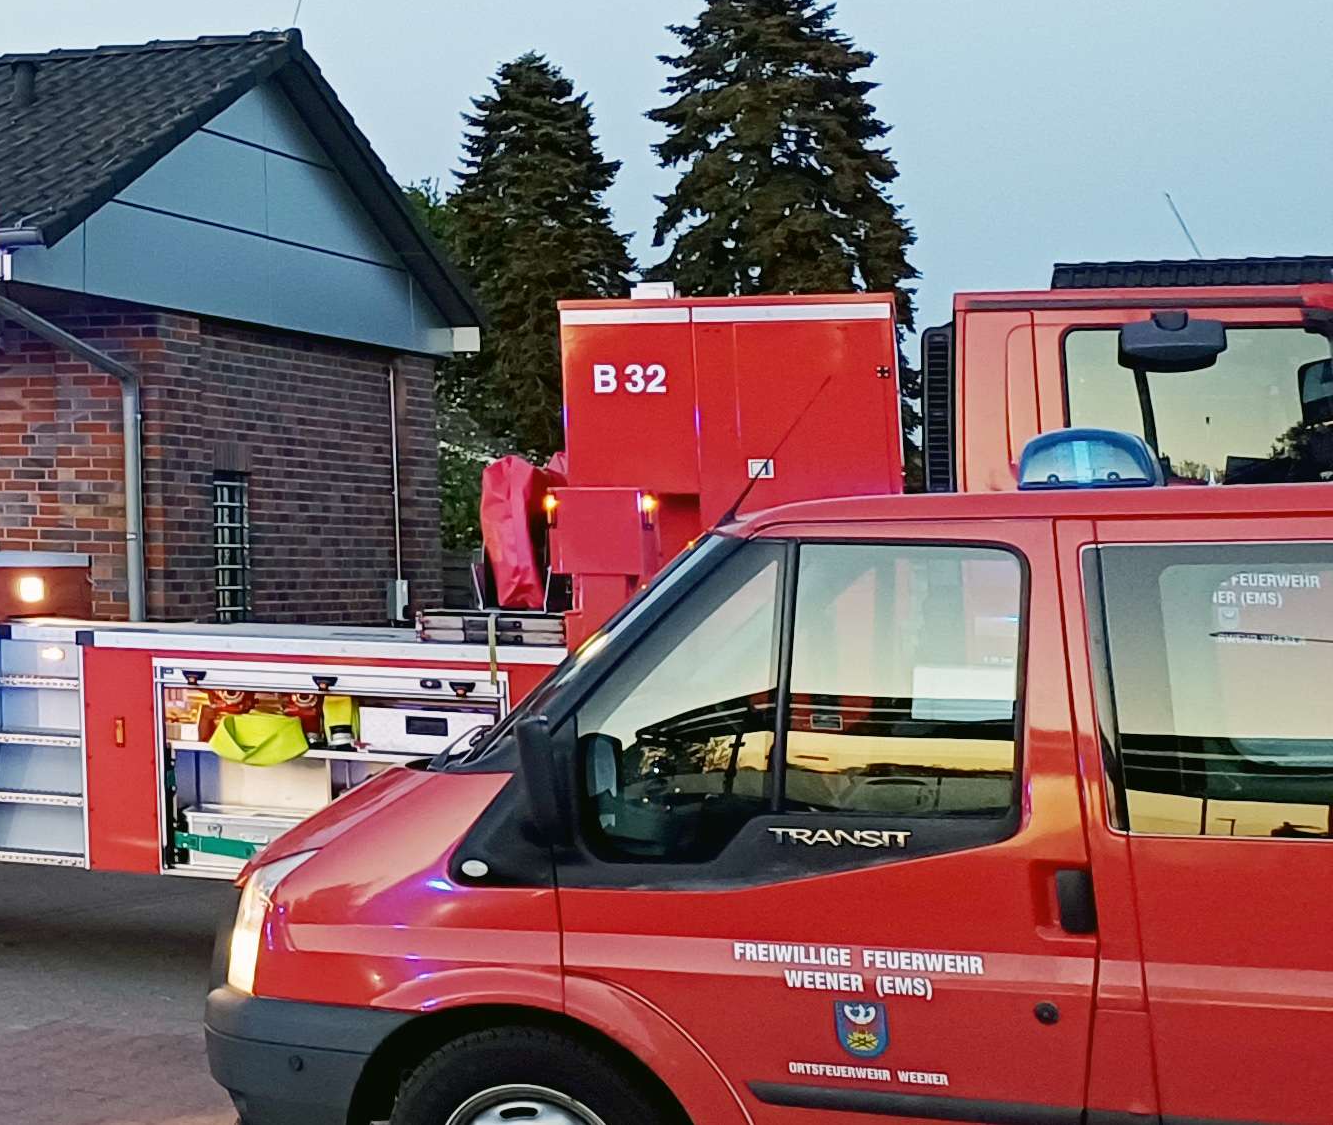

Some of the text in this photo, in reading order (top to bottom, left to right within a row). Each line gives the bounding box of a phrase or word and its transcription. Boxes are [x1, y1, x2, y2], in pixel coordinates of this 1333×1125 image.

[593, 363, 666, 393] B 32
[1241, 591, 1283, 609] (EMS)
[768, 827, 912, 848] TRANSIT
[733, 942, 984, 975] FREIWILLIGE FEUERWEHR
[784, 970, 933, 1001] WEENER (EMS)
[788, 1061, 949, 1087] ORTSFEUERWEHR WEENER
